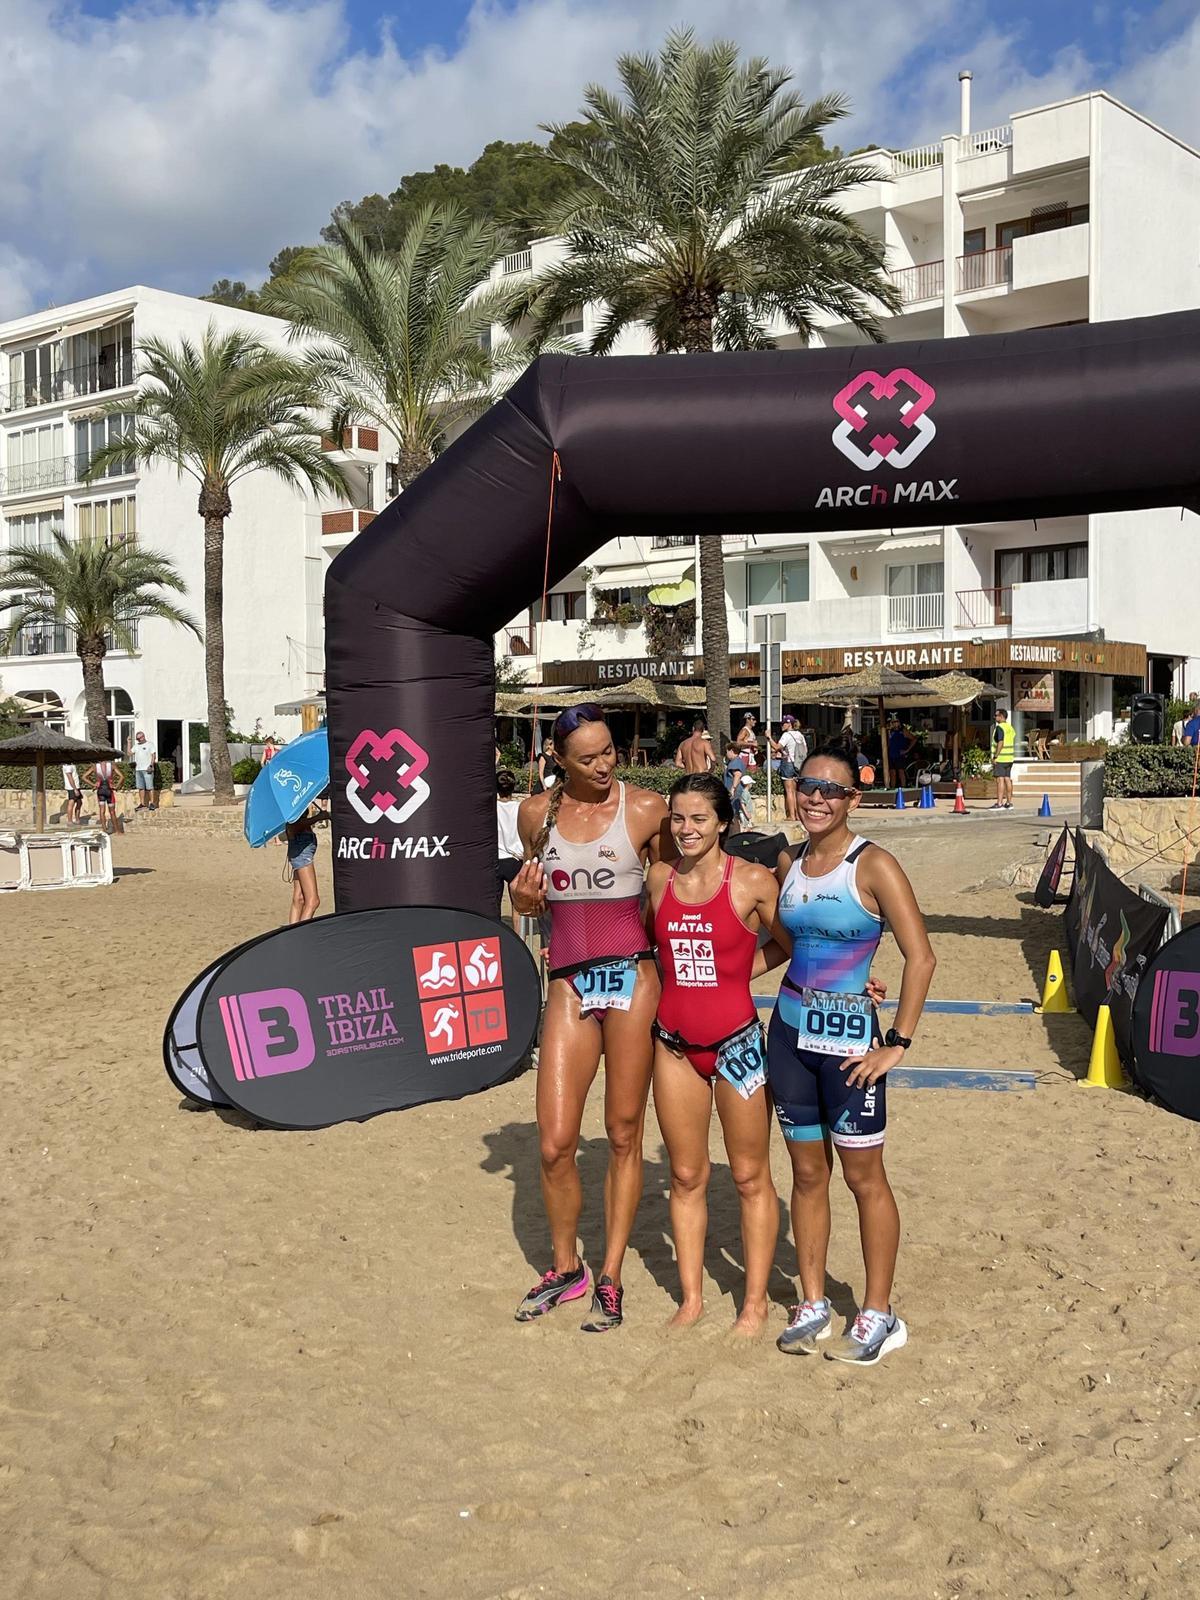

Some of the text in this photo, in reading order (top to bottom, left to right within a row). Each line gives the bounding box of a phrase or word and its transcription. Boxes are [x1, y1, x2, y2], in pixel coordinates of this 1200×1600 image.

[814, 484, 888, 508] ARCh
[843, 647, 964, 668] RESTAURANTE
[1010, 644, 1057, 663] RESTAURANTE
[598, 660, 695, 679] RESTAURANTE
[337, 836, 387, 860] ARCh
[551, 867, 616, 892] one
[667, 921, 713, 933] MATAS
[583, 970, 625, 994] 015
[697, 965, 715, 976] TD
[317, 987, 394, 1019] TRAIL
[326, 1012, 398, 1045] IBIZA
[469, 1006, 501, 1033] TD
[806, 1009, 866, 1040] 099
[429, 1043, 502, 1066] www.trideporte.com
